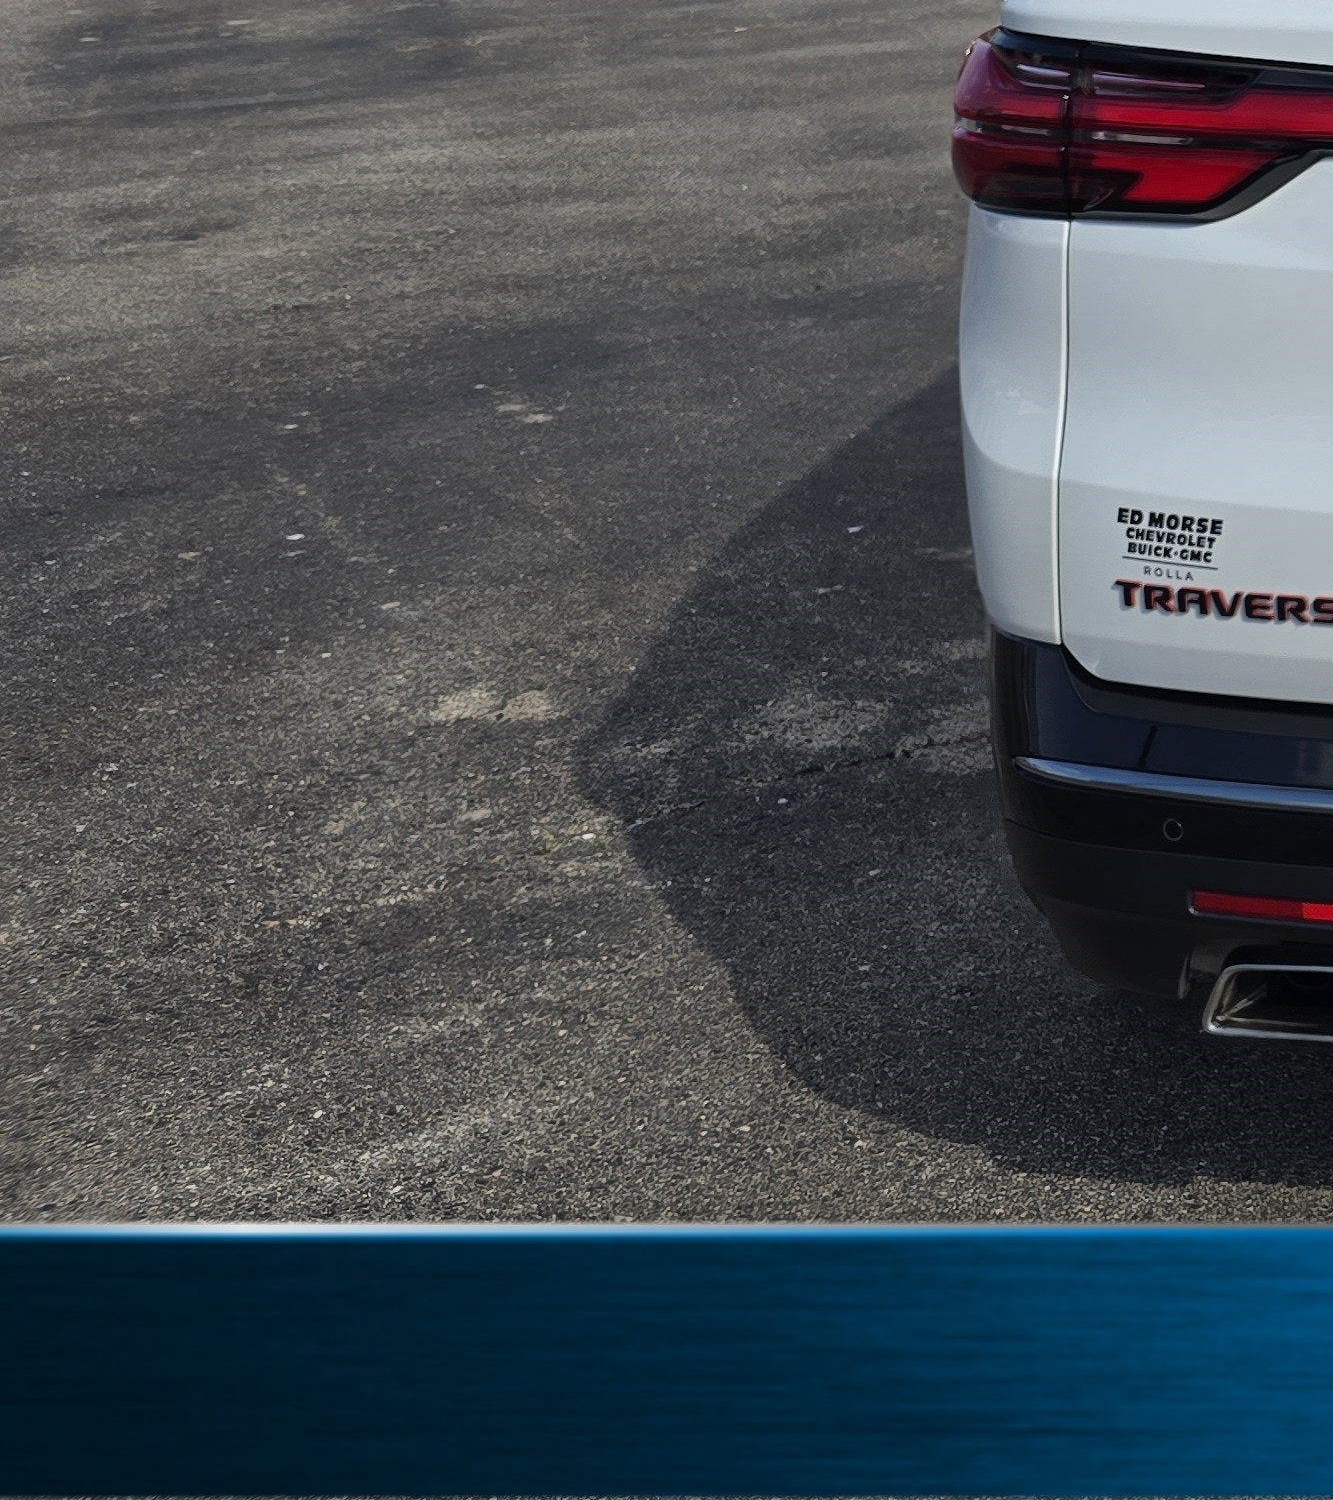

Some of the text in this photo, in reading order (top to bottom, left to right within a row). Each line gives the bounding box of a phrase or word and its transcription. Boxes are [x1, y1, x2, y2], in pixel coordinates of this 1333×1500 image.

[1117, 507, 1224, 535] ED MORSE
[1126, 527, 1217, 549] CHEVROLET
[1143, 565, 1194, 581] ROLLA
